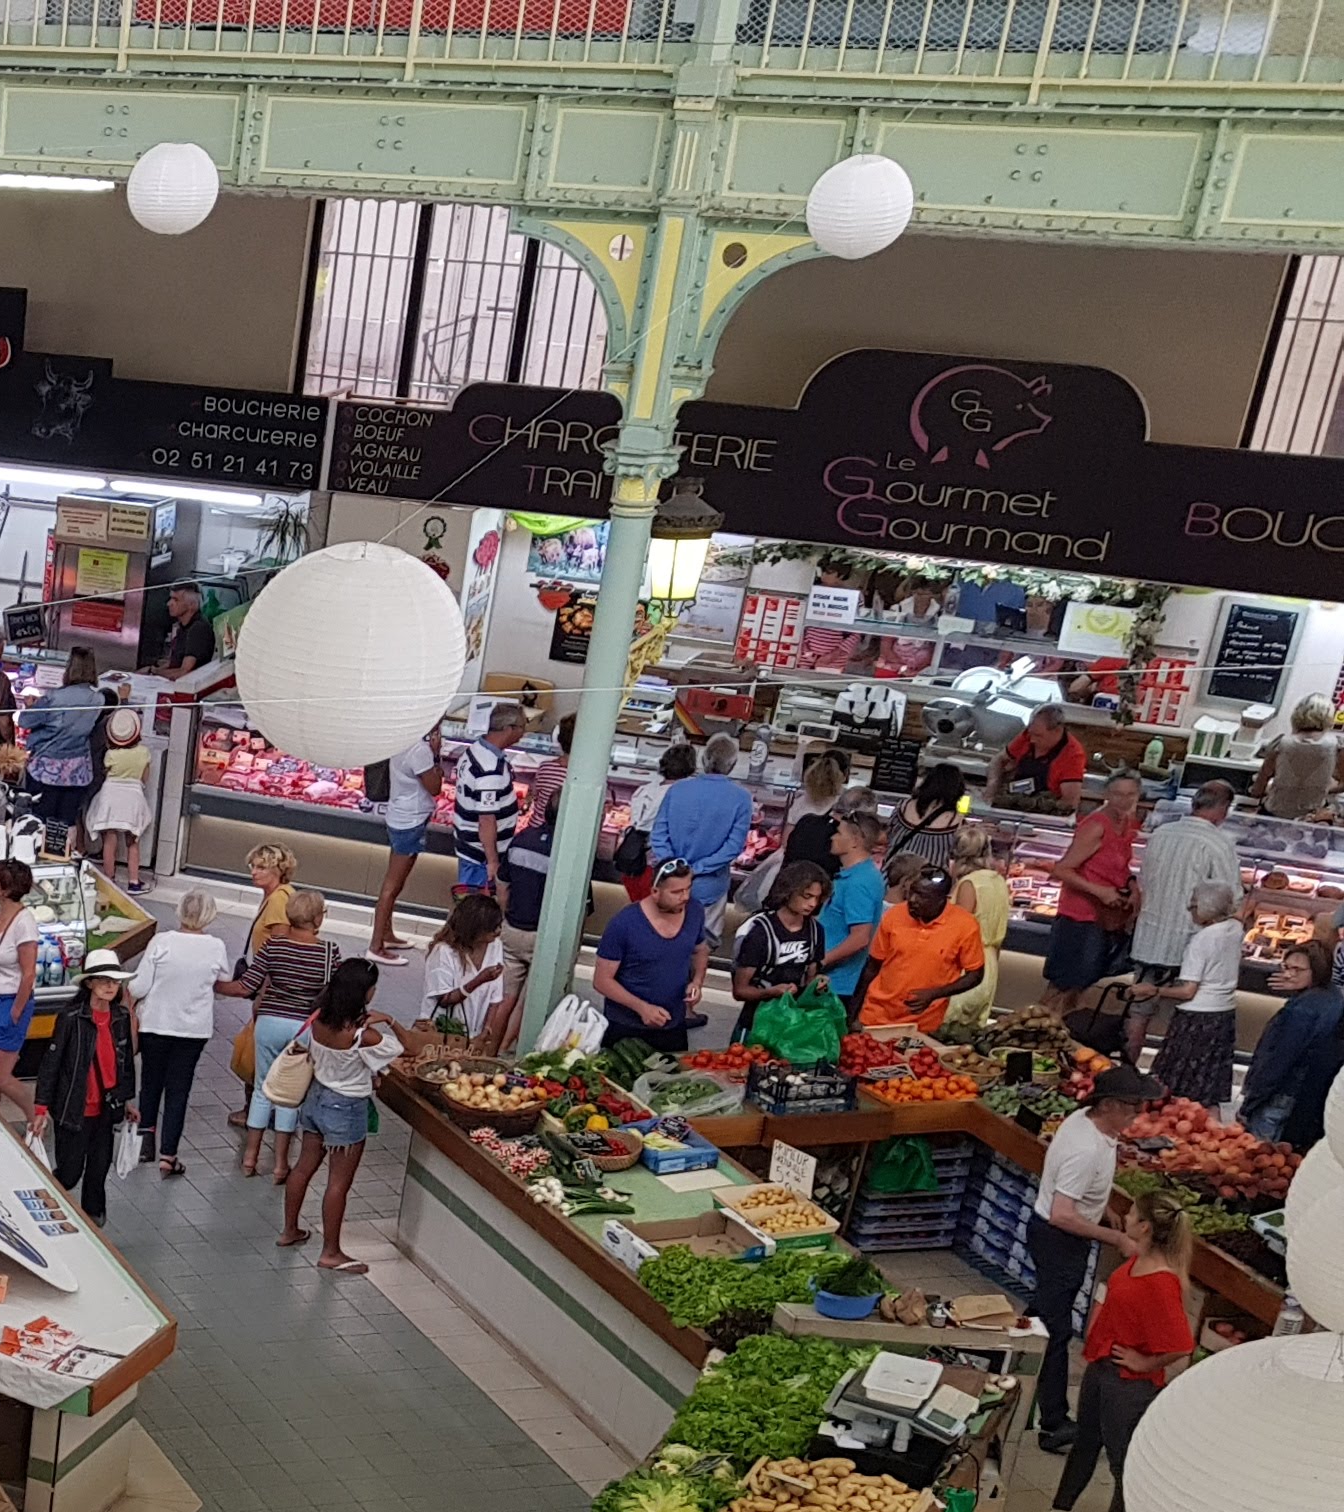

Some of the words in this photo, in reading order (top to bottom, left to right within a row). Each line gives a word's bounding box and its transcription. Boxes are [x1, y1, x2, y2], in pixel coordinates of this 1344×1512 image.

[204, 396, 320, 421] BOUCHERIE
[355, 406, 433, 429] COCHON
[353, 424, 405, 442] BOEUF
[350, 443, 422, 462] AGNEAU
[884, 451, 916, 472] Le
[152, 448, 180, 467] 02
[223, 455, 245, 473] 21
[255, 459, 278, 477] 41
[289, 461, 313, 480] 73
[350, 460, 422, 480] VOLAILLE
[347, 477, 389, 494] VEAU
[823, 456, 1056, 519] Gourmet
[836, 494, 1110, 563] Gourmand
[779, 941, 807, 953] NIKE
